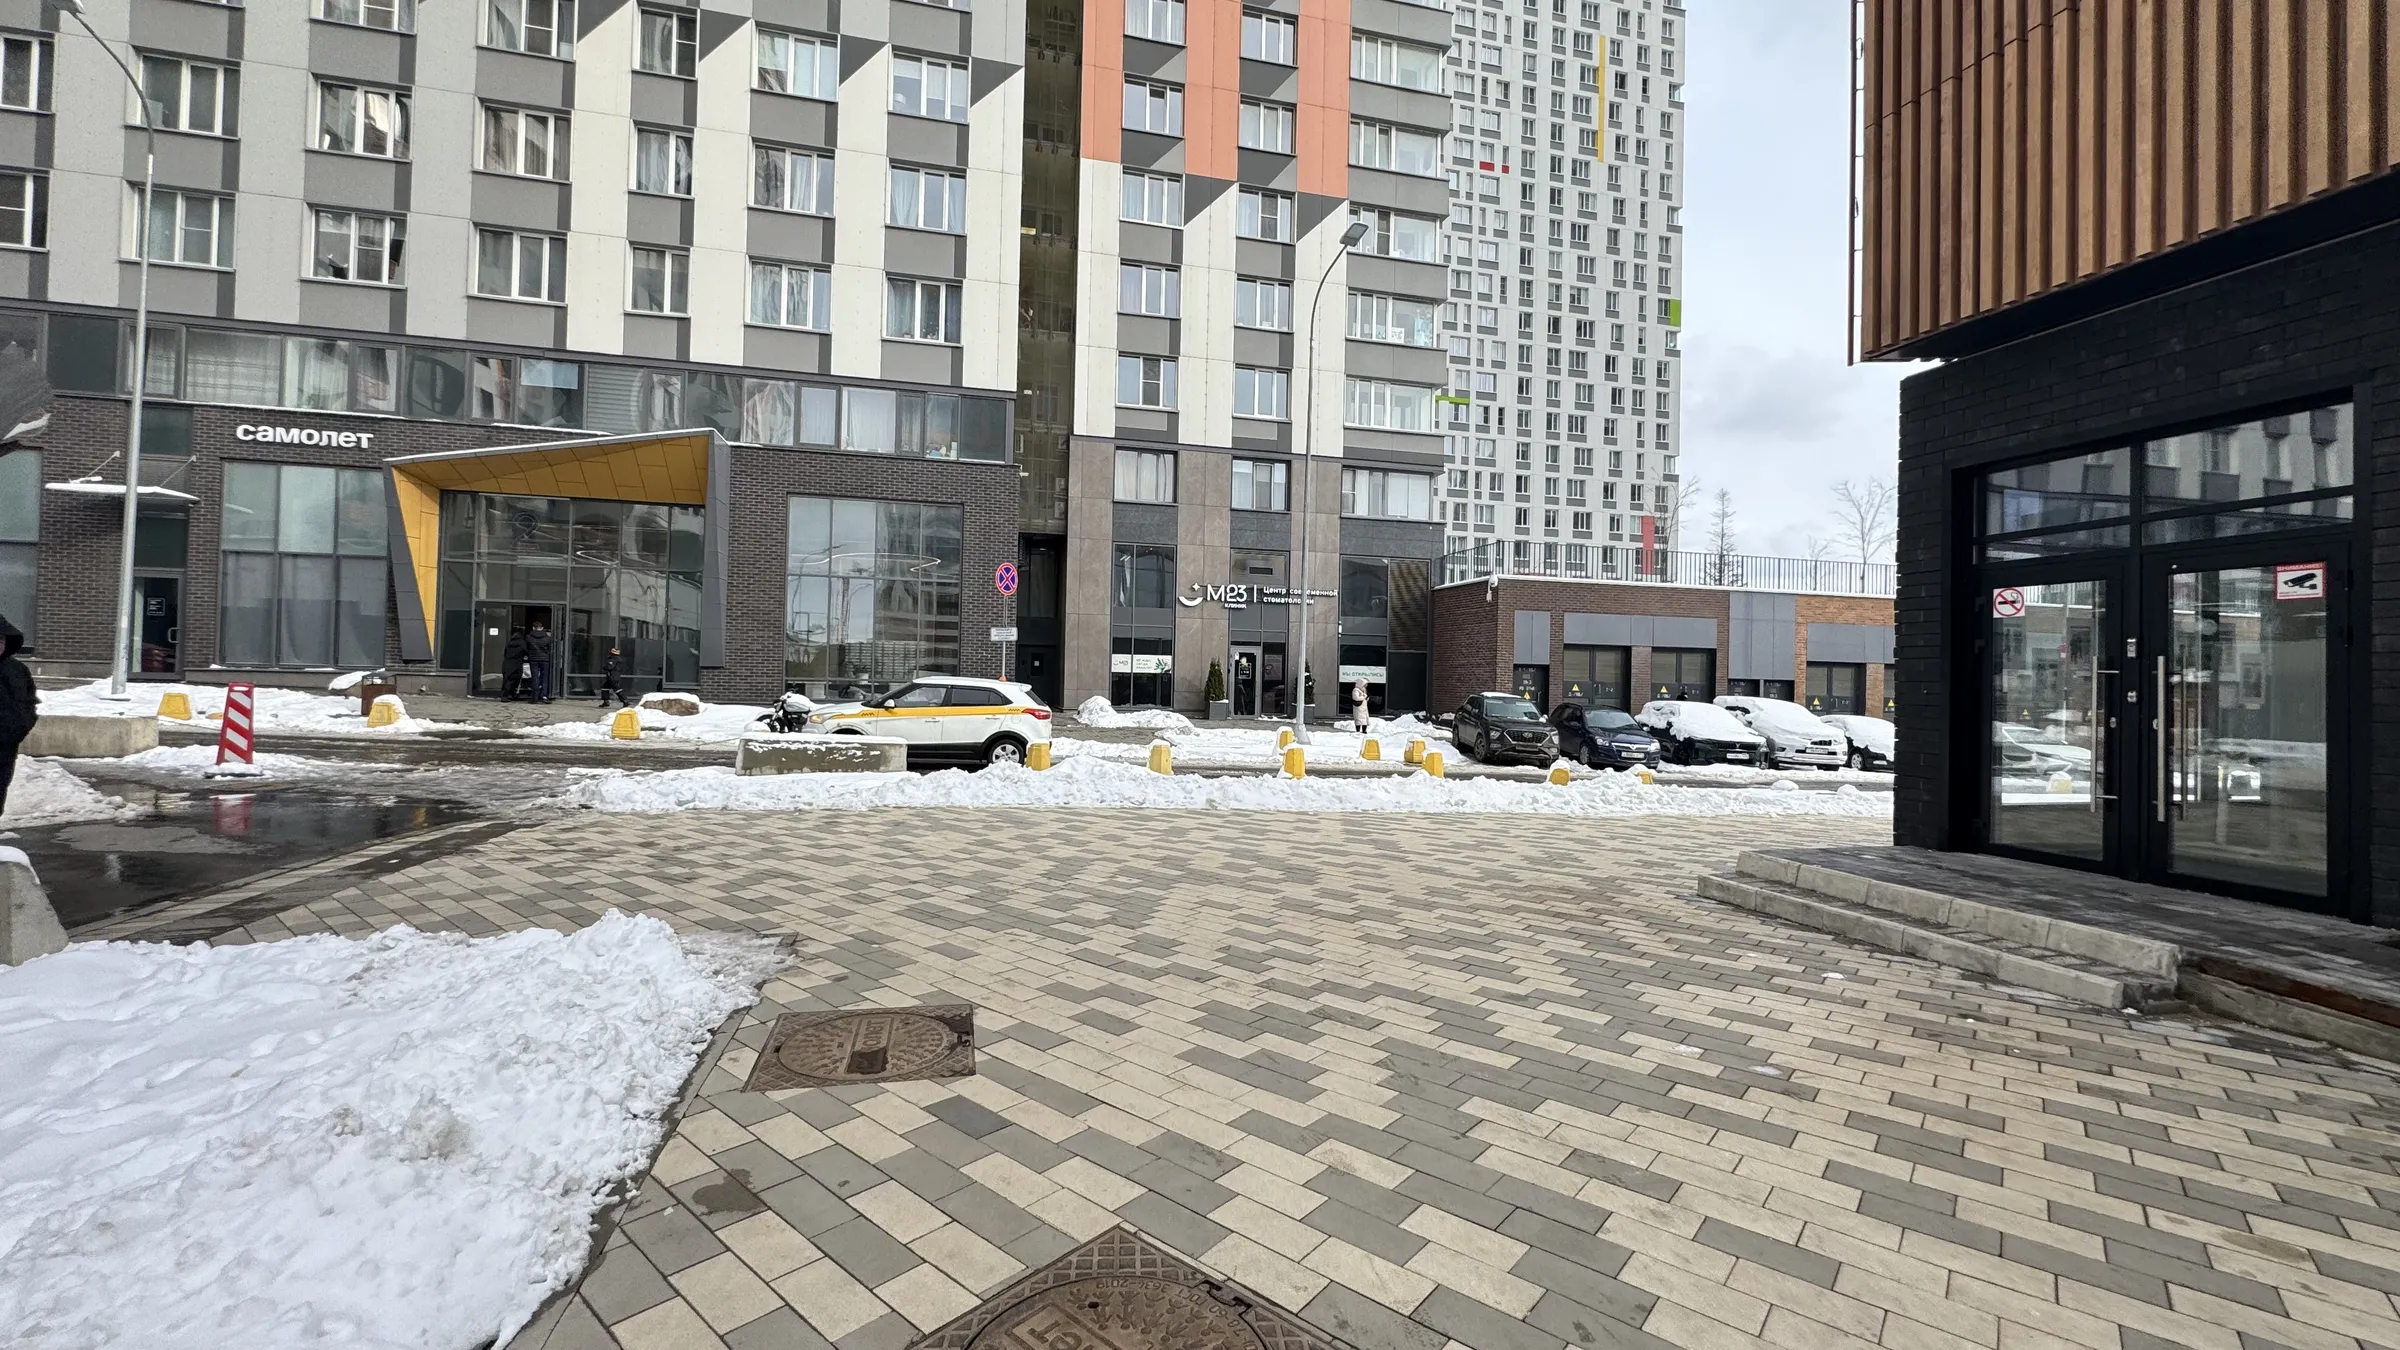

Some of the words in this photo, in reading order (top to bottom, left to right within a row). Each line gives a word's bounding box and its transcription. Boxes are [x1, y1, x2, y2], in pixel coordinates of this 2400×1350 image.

[236, 424, 374, 449] самолет
[1263, 586, 1287, 595] Центр
[1289, 588, 1339, 597] совеменной
[1263, 597, 1315, 605] стоматолоии
